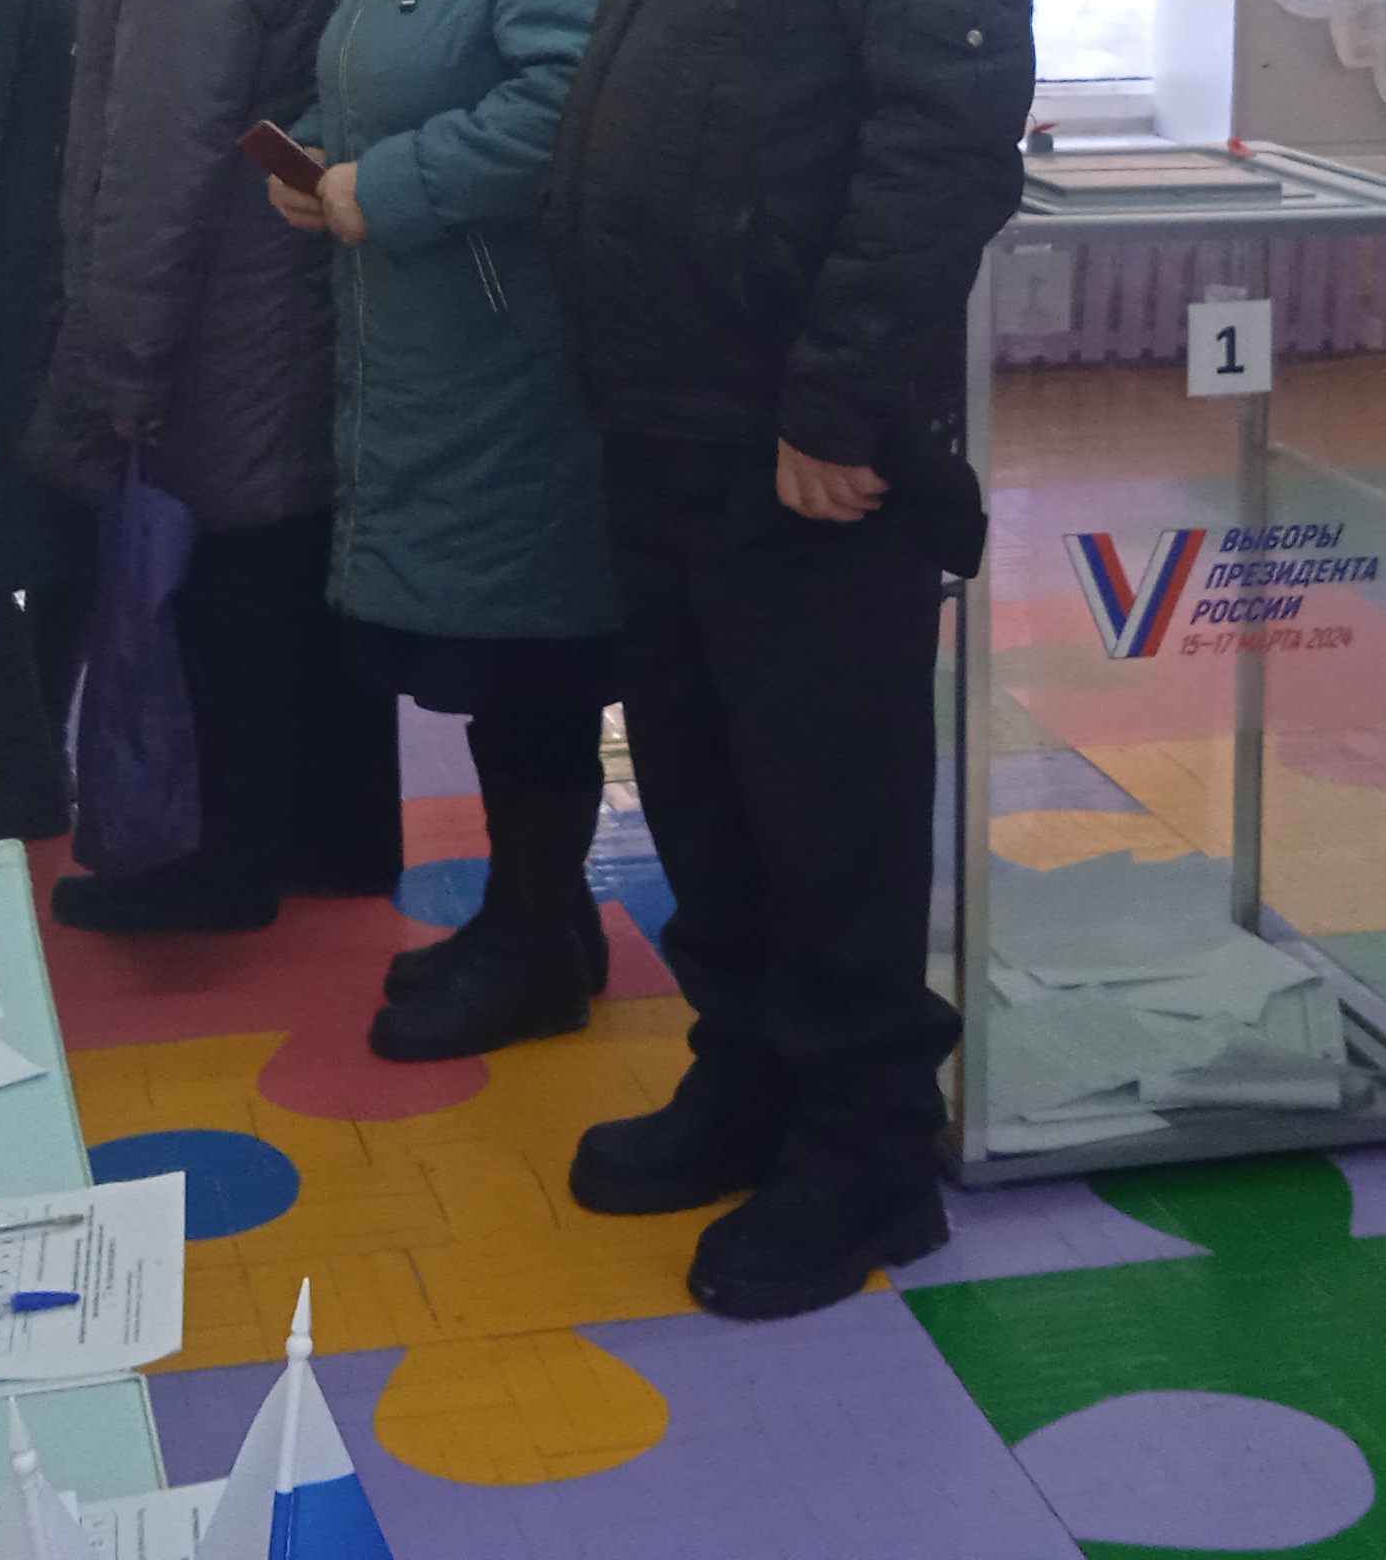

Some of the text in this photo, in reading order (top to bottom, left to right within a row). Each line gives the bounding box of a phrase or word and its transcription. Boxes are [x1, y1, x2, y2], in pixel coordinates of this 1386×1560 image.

[1215, 326, 1245, 374] 1
[1219, 523, 1345, 553] ВЫБОРЫ
[1205, 557, 1379, 589] ПРЕЗИДЕНТА
[1190, 595, 1304, 625] РОССИИ
